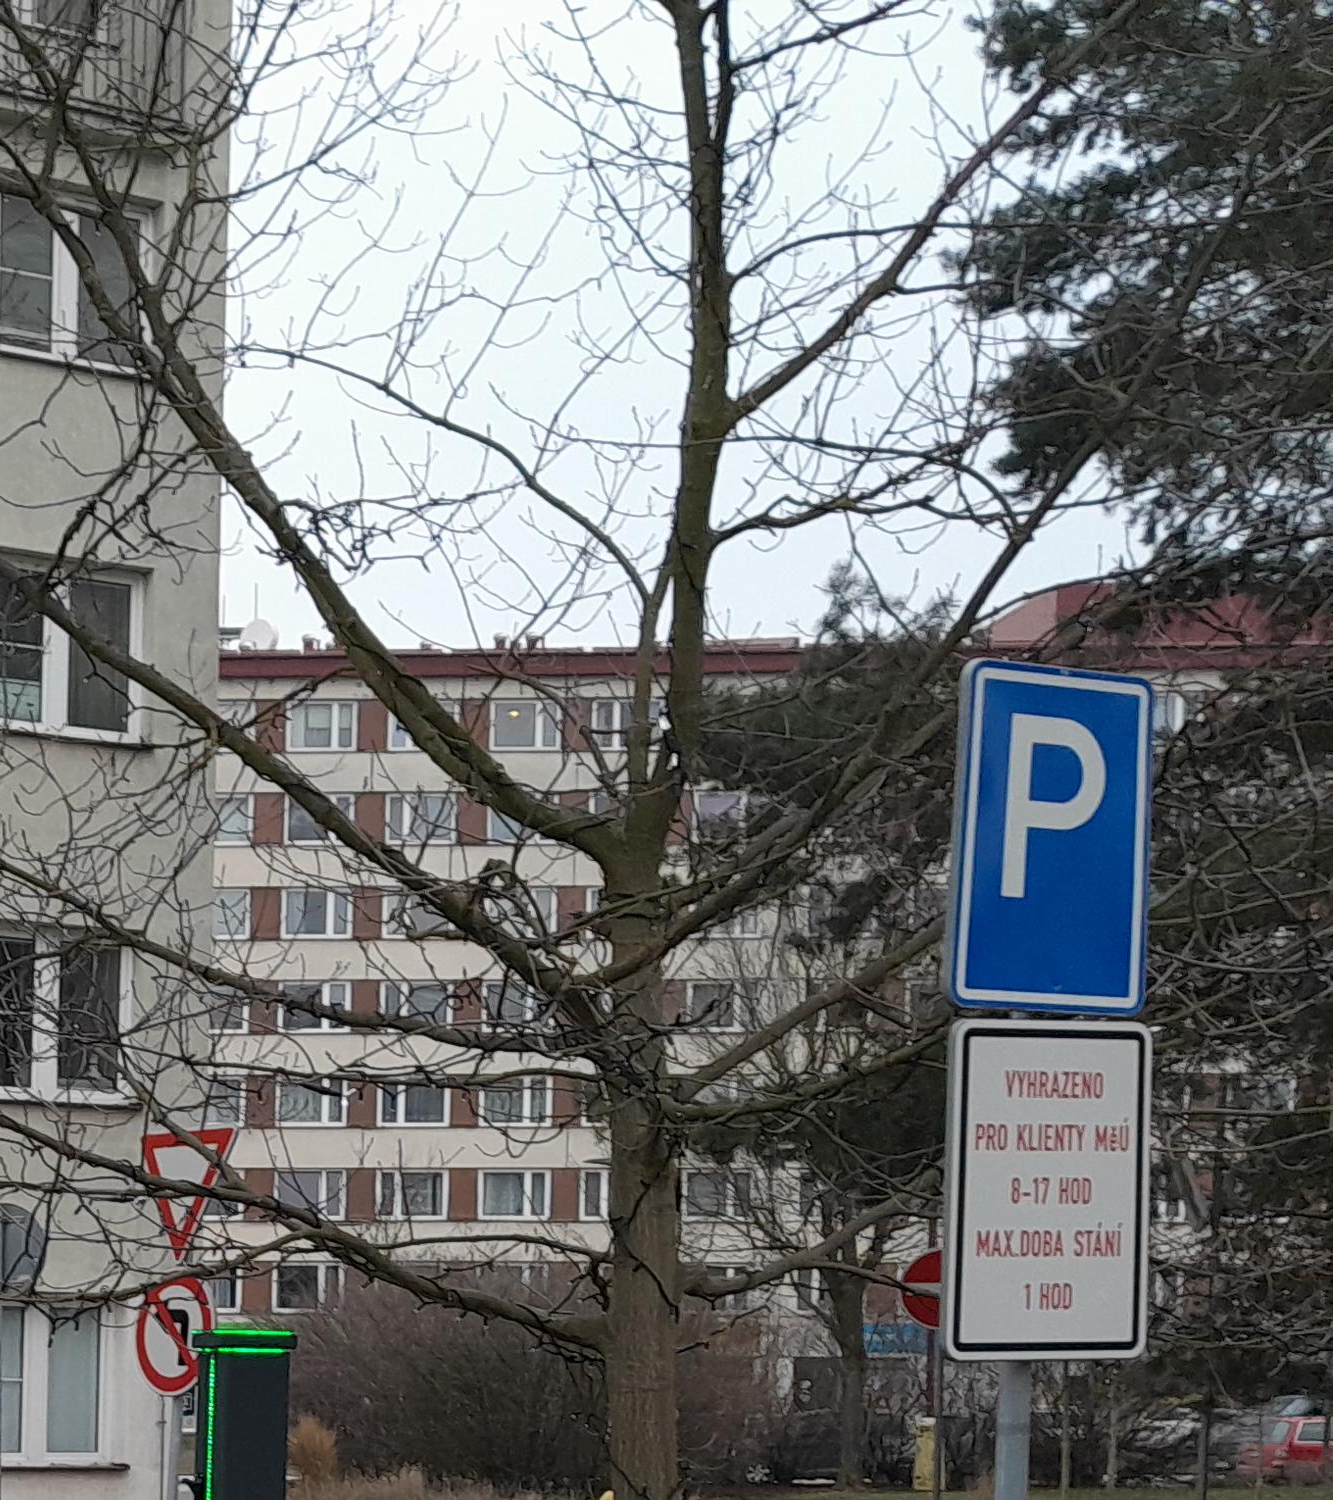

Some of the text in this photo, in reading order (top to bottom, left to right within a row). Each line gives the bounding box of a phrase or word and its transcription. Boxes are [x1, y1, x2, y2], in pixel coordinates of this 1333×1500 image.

[1001, 713, 1106, 898] P
[1005, 1070, 1104, 1099] VYHRAZENO
[975, 1117, 1130, 1152] PRO KLIENTY MěÚ
[1011, 1177, 1093, 1205] 8-17 HOD
[1073, 1222, 1123, 1258] STÁNÍ
[1023, 1282, 1073, 1310] 1 HOD
